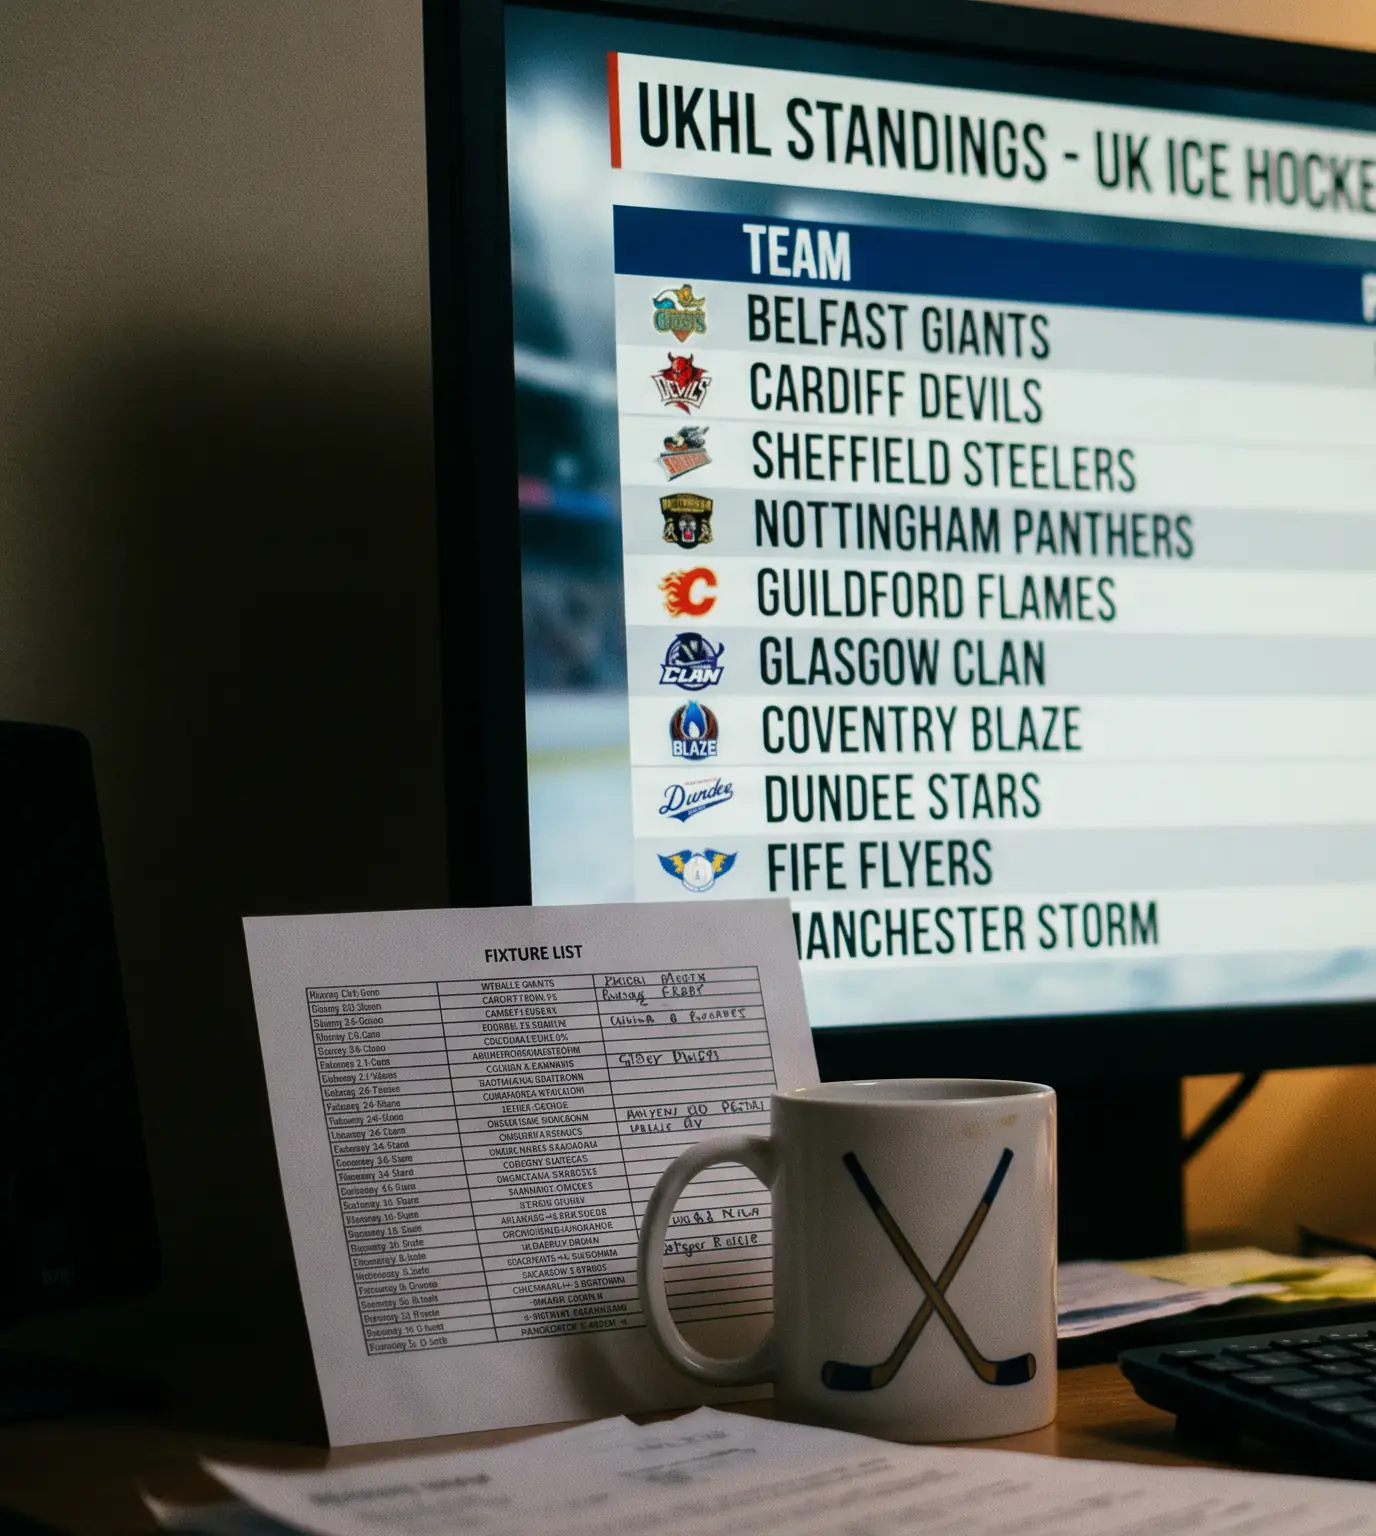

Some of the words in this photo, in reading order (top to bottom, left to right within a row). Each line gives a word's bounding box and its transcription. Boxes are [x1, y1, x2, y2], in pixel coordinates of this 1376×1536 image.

[638, 81, 772, 157] UKHL
[786, 97, 1048, 182] STANDINGS
[1095, 130, 1152, 193] UK
[1166, 137, 1231, 201] ICE
[742, 223, 851, 281] TEAM
[747, 294, 909, 352] BELFAST
[921, 306, 1051, 361] GIANTS
[650, 373, 713, 410] DEVILS
[749, 361, 906, 418] CARDIFF
[919, 371, 1043, 425] DEVILS
[751, 430, 951, 486] SHEFFIELD
[963, 440, 1137, 494] STEELERS
[754, 498, 1001, 554] NOTTINGHAM
[1013, 508, 1194, 560] PANTHERS
[757, 567, 964, 619] GUILDFORD
[977, 573, 1117, 623] FLAMES
[660, 665, 723, 684] CLAN
[759, 635, 940, 687] GLASGOW
[953, 638, 1046, 687] CLAN
[673, 739, 718, 757] BLAZE
[762, 704, 958, 755] COVENTRY
[971, 705, 1082, 752] BLAZE
[659, 777, 733, 815] Dundee
[764, 773, 916, 824] DUNDEE
[927, 771, 1041, 821] STARS
[767, 841, 847, 893] FIFE
[859, 838, 993, 890] FLYERS
[1037, 900, 1159, 951] STORM
[484, 947, 549, 963] FIXTURE
[553, 945, 583, 960] LIST
